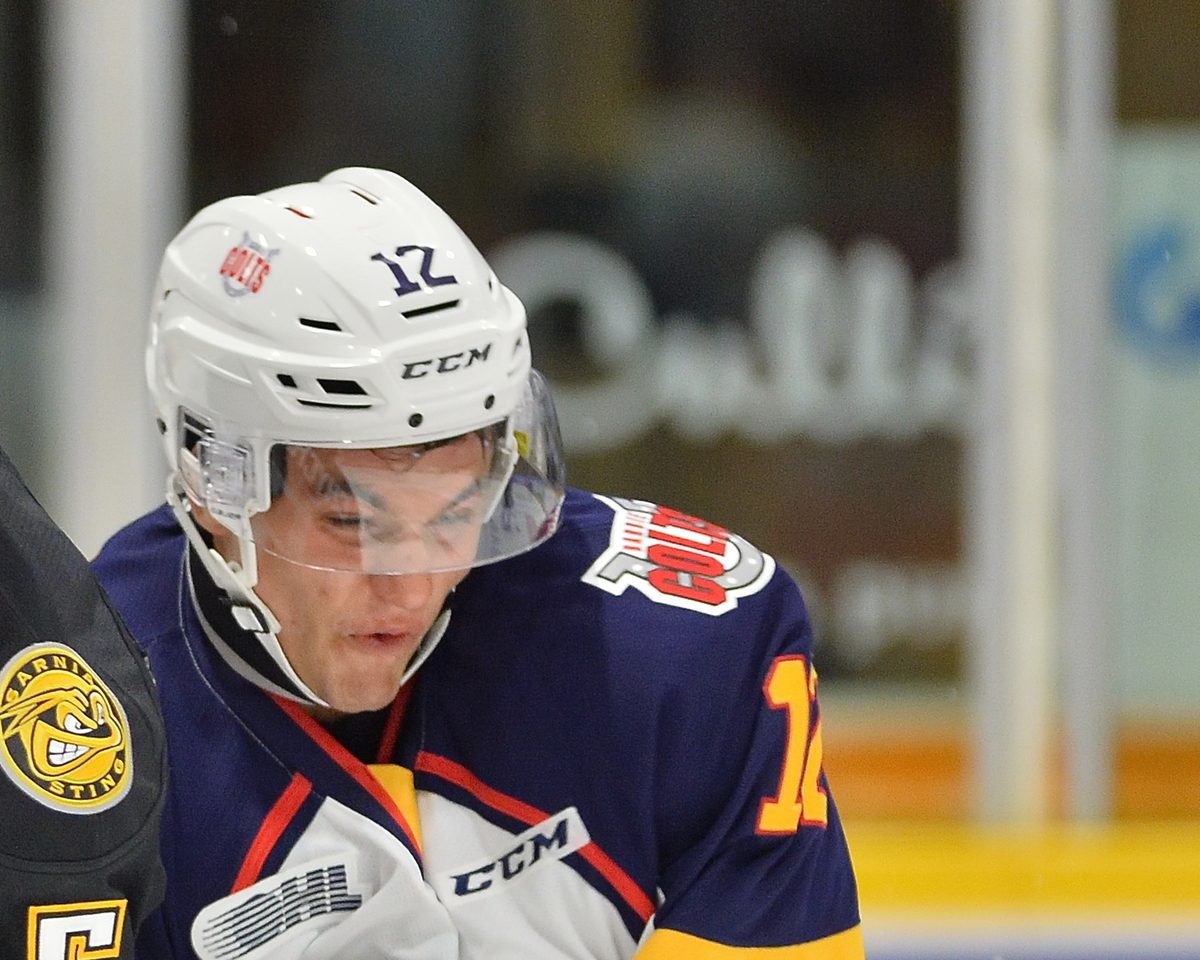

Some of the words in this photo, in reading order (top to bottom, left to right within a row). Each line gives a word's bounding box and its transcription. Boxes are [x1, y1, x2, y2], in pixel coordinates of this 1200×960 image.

[371, 245, 458, 297] 12
[402, 343, 492, 379] CCM
[7, 655, 96, 703] SARNIA
[49, 758, 125, 798] STING
[450, 818, 568, 897] CCM
